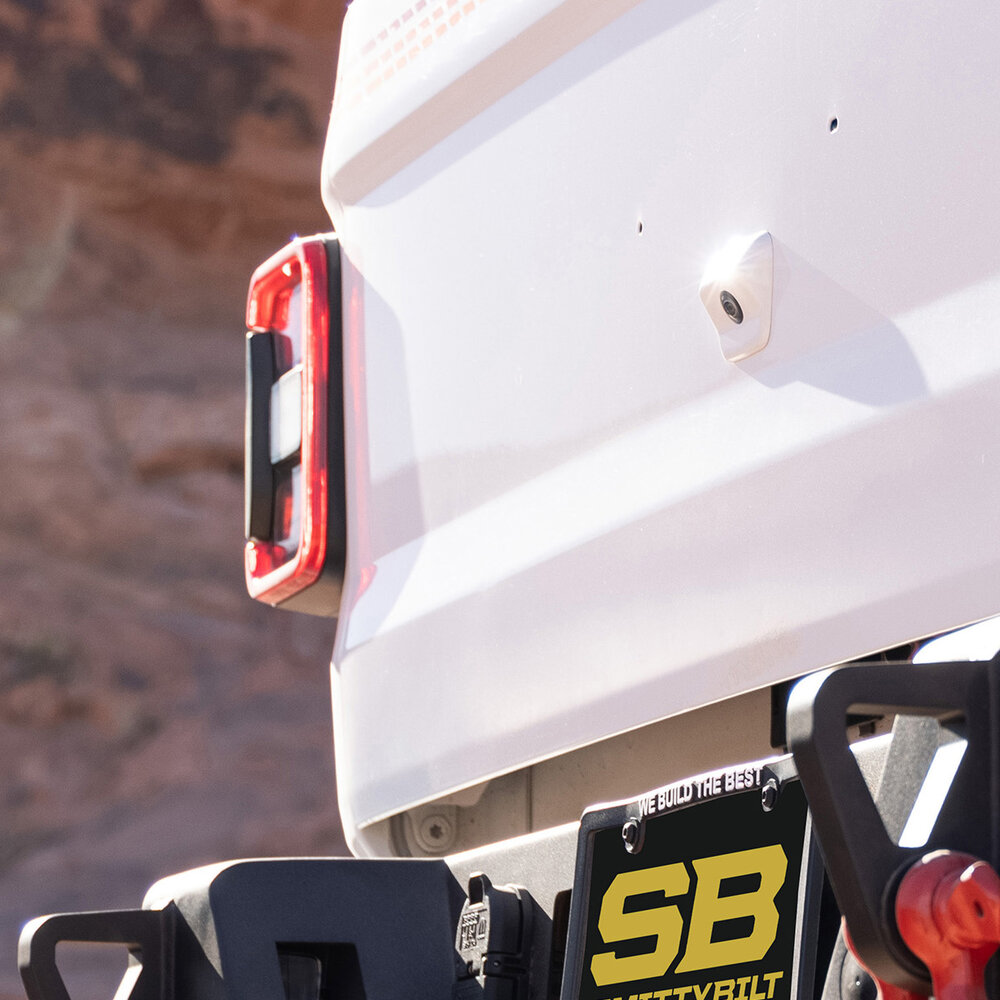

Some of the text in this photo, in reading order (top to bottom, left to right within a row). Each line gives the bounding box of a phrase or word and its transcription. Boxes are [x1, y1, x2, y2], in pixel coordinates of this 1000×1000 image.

[638, 766, 764, 816] WE BUILD THE BEST
[590, 844, 789, 987] SB
